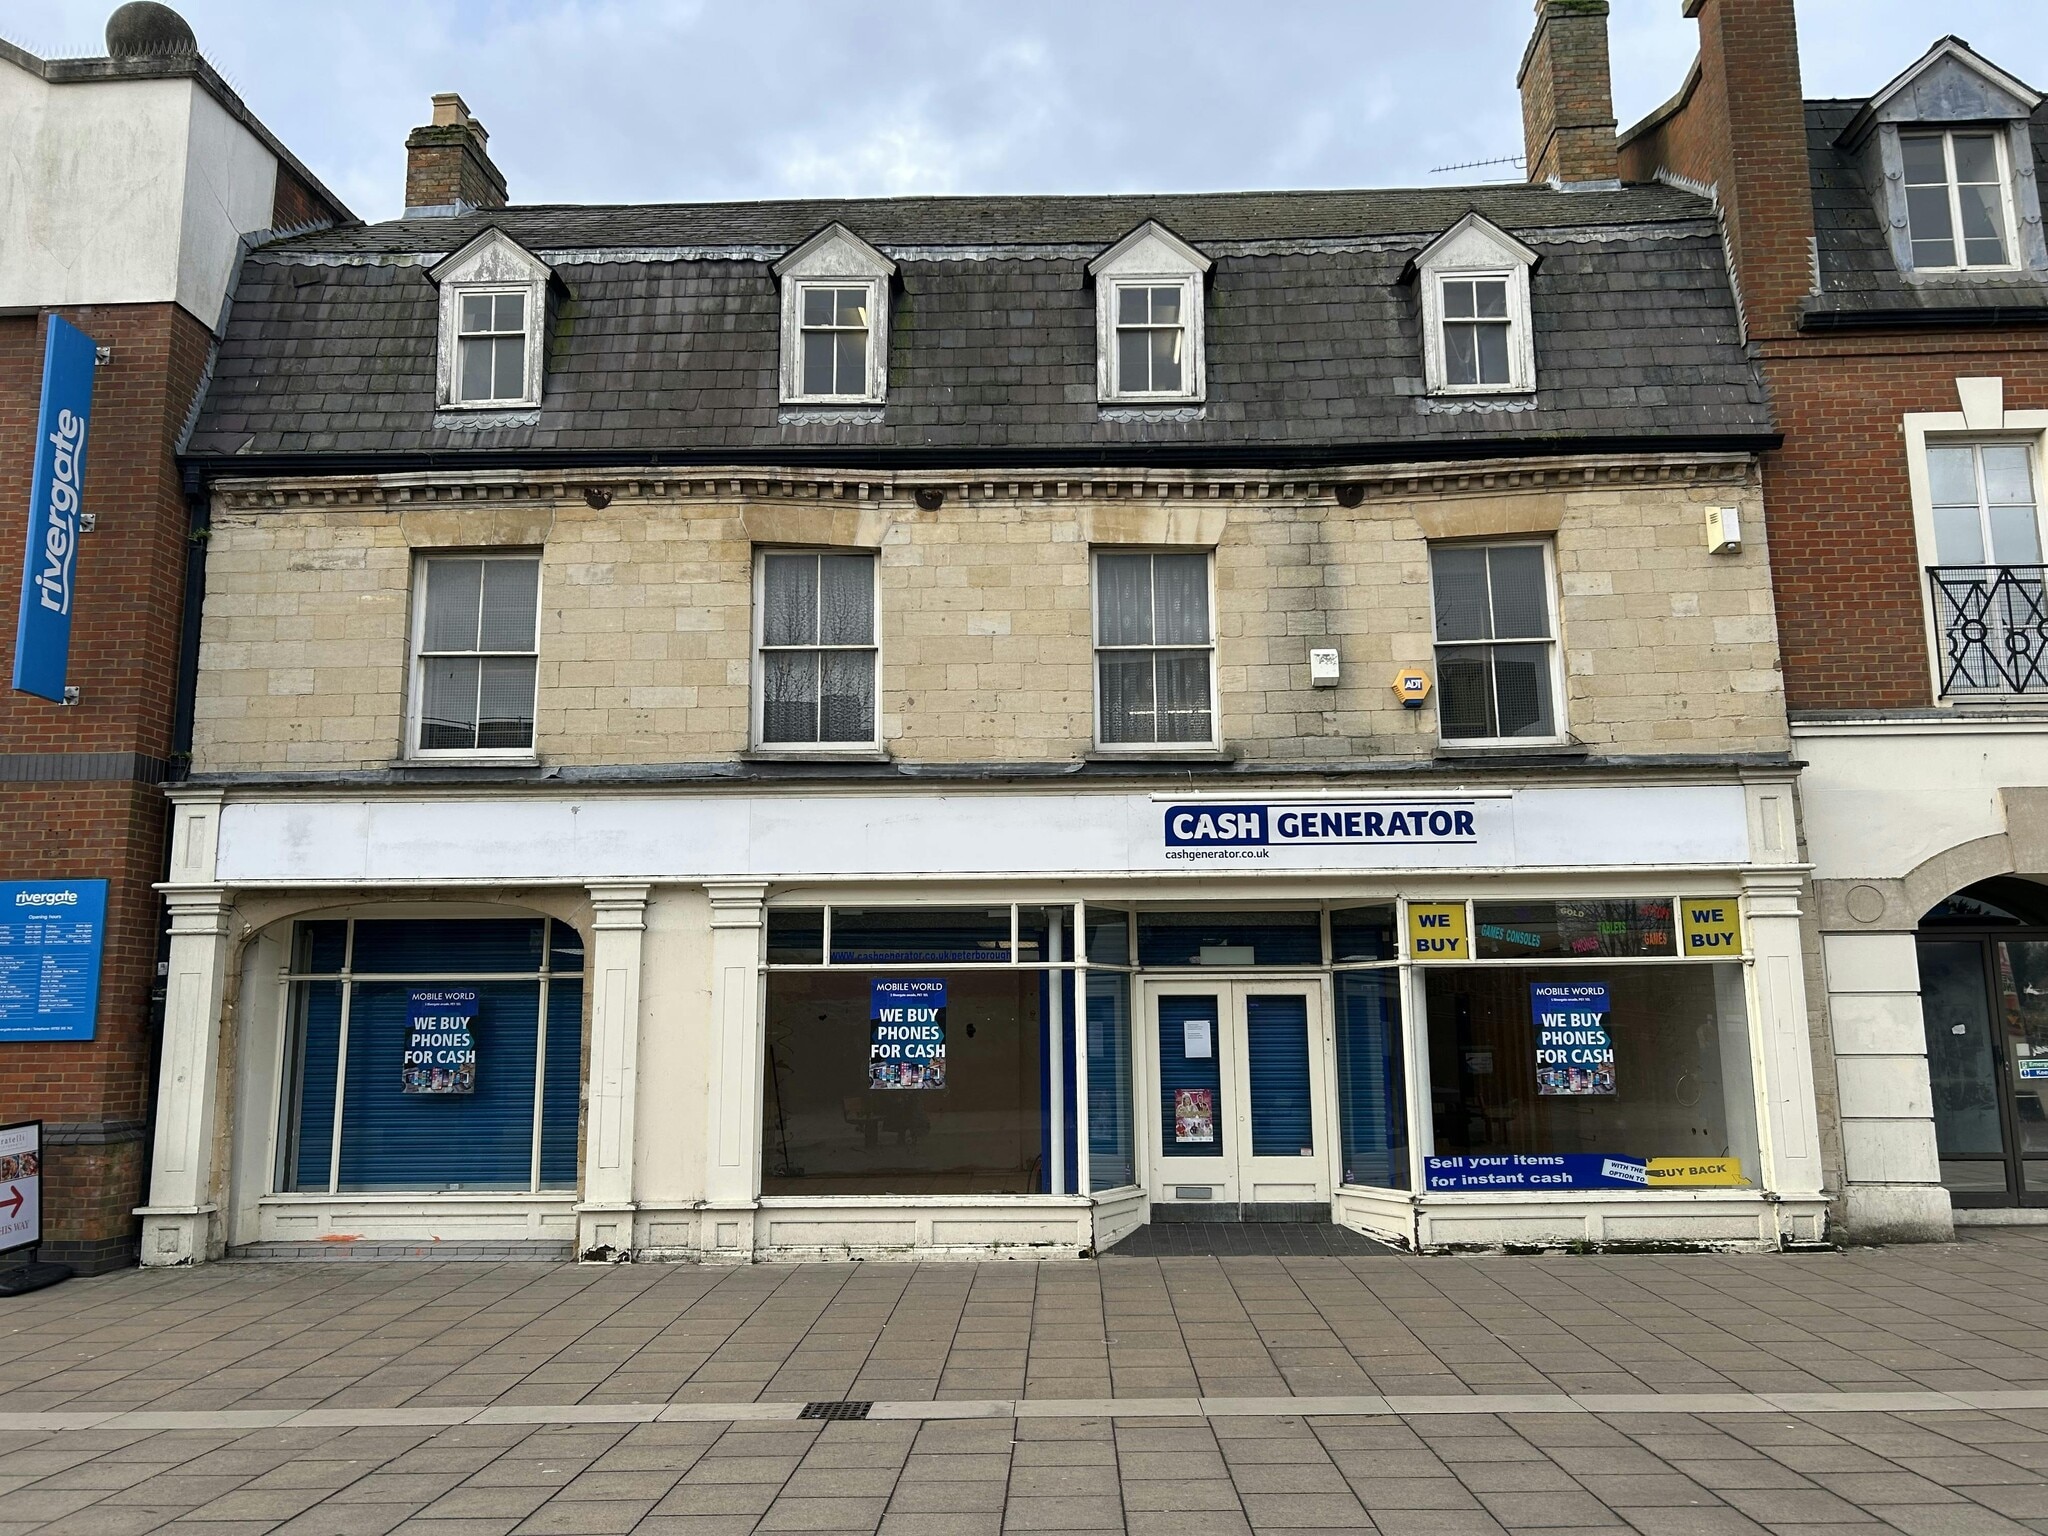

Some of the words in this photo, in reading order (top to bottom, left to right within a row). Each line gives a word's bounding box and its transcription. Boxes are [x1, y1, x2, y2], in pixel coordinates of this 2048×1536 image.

[35, 409, 78, 610] rivergate
[1404, 679, 1423, 689] ADT
[1172, 813, 1260, 840] CASH
[1277, 810, 1476, 838] GENERATOR
[1165, 849, 1269, 861] cashgenerator.co.uk
[15, 890, 78, 906] rivergate
[1560, 907, 1585, 918] GOLD
[1692, 909, 1725, 923] WE
[1418, 914, 1451, 928] WE
[1481, 924, 1504, 941] GAMES
[1505, 929, 1541, 948] CONSOLES
[1644, 931, 1668, 946] GAMES
[1691, 933, 1734, 947] BUY
[1416, 938, 1460, 952] BUY
[1570, 936, 1600, 953] PHONES
[876, 983, 909, 991] MOBILE
[910, 983, 943, 991] WORLD
[1536, 988, 1570, 996] MOBILE
[1571, 987, 1604, 995] WORLD
[412, 993, 443, 1001] MOBILE
[879, 1008, 903, 1022] WE
[907, 1008, 939, 1022] BUY
[1541, 1013, 1566, 1027] WE
[1570, 1013, 1603, 1027] BUY
[413, 1017, 437, 1030] WE
[440, 1017, 471, 1030] BUY
[411, 1033, 471, 1047] PHONES
[877, 1026, 940, 1040] PHONES
[1541, 1031, 1606, 1045] PHONES
[404, 1050, 433, 1064] FOR
[436, 1050, 476, 1064] CASH
[871, 1044, 901, 1058] FOR
[904, 1044, 946, 1058] CASH
[1536, 1049, 1567, 1064] FOR
[1571, 1049, 1614, 1063] CASH
[1429, 1157, 1463, 1169] Sell
[1468, 1157, 1510, 1170] your
[1513, 1155, 1565, 1166] items
[1611, 1162, 1629, 1172] WITH
[1629, 1165, 1644, 1175] THE
[1608, 1170, 1635, 1181] OPTION
[1635, 1175, 1646, 1183] TO
[1658, 1167, 1685, 1178] BUY
[1688, 1164, 1727, 1175] BACK
[1431, 1176, 1459, 1187] for
[1462, 1173, 1525, 1185] instant
[1529, 1172, 1573, 1184] cash
[13, 1219, 30, 1231] WAY
